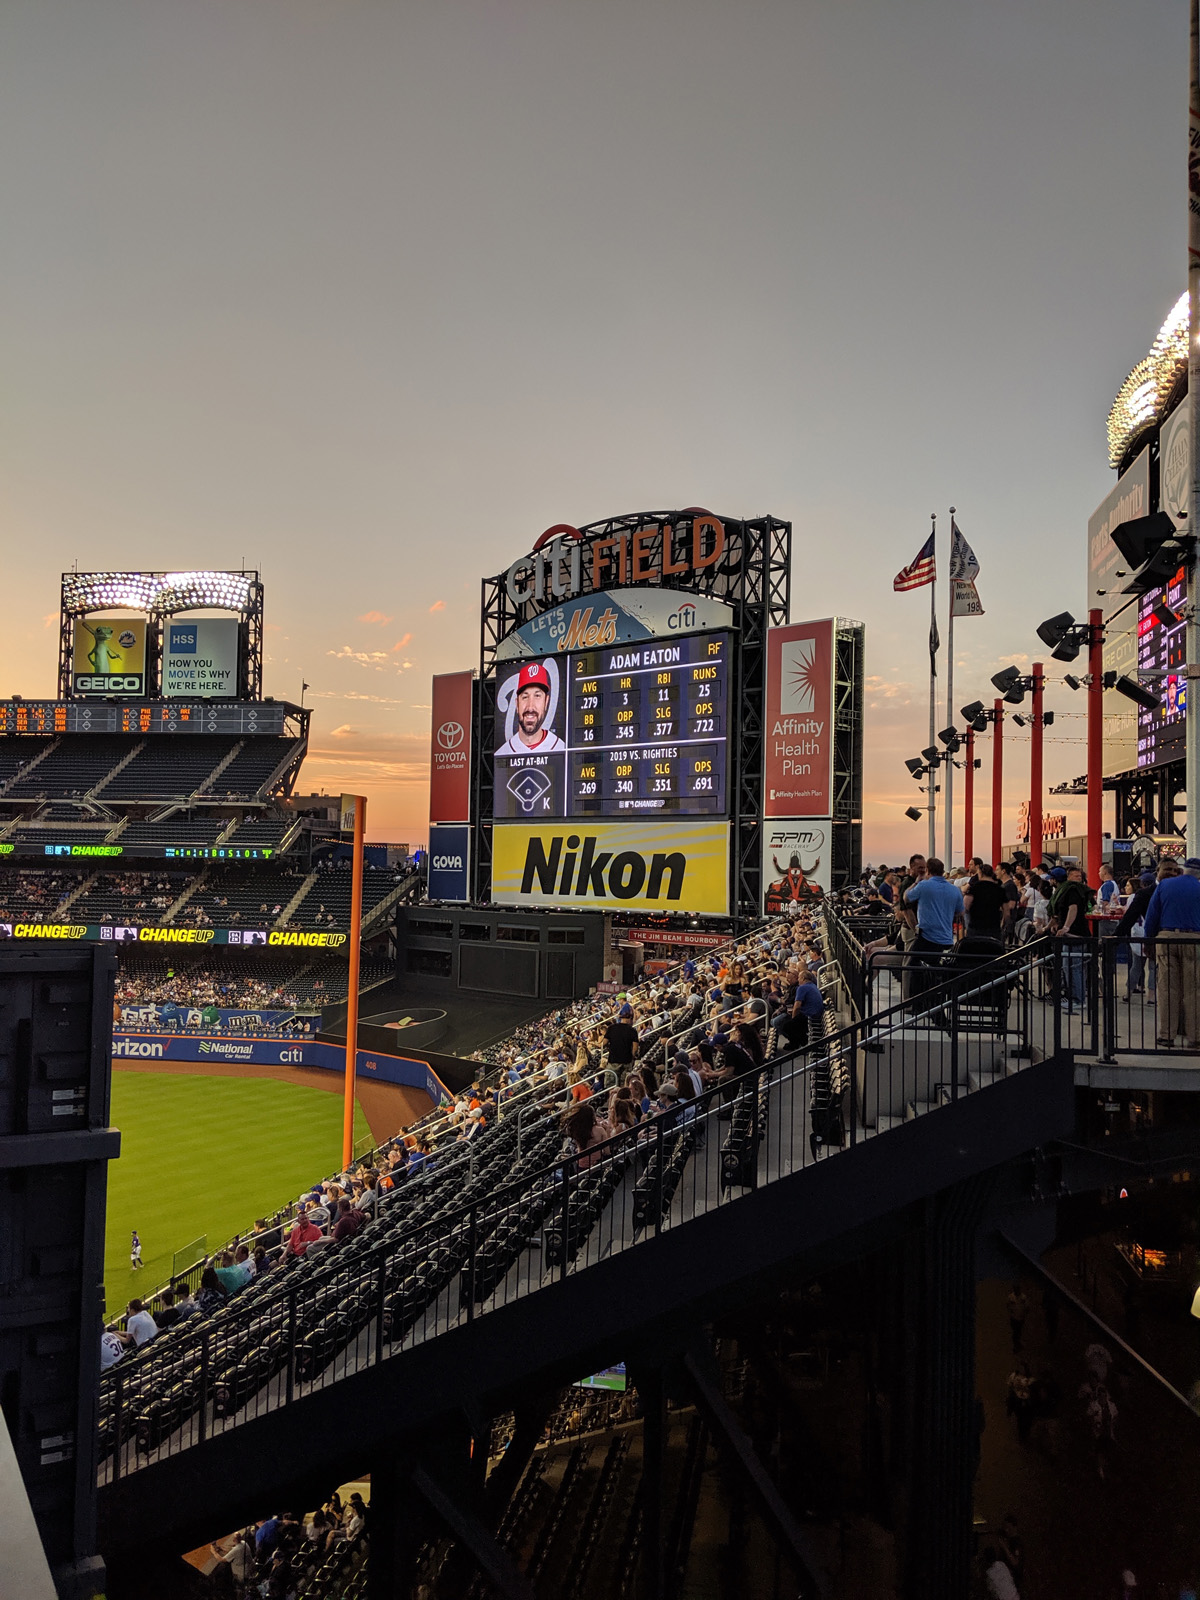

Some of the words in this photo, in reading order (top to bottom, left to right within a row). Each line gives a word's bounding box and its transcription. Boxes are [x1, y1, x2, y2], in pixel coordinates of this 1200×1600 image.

[593, 516, 725, 588] FIELD
[668, 608, 695, 630] citi
[531, 608, 565, 633] LET'S
[549, 621, 565, 639] GO
[557, 607, 617, 651] Mets
[172, 635, 194, 644] HSS
[168, 659, 191, 668] HOW
[193, 659, 213, 668] YOU
[577, 662, 583, 673] 2
[610, 653, 640, 670] ADAM
[643, 647, 680, 666] EATON
[708, 642, 722, 655] RF
[168, 670, 195, 679] MOVE
[197, 670, 207, 679] IS
[208, 670, 231, 679] WHY
[582, 682, 597, 693] AVG
[620, 678, 631, 689] HR
[657, 673, 671, 684] RBI
[693, 667, 717, 680] RUNS
[76, 677, 140, 690] GEICO
[168, 681, 197, 690] WE'RE
[199, 681, 226, 690] HERE.
[580, 697, 598, 709] .279
[623, 694, 628, 705] 3
[658, 690, 669, 701] 11
[699, 685, 710, 697] 25
[584, 715, 594, 725] BB
[617, 711, 633, 722] OBP
[656, 707, 671, 719] SLG
[695, 703, 713, 715] OPS
[583, 730, 594, 741] 16
[615, 726, 634, 738] .345
[653, 723, 673, 735] .377
[693, 719, 714, 732] .722
[772, 719, 824, 737] Affinity
[610, 751, 627, 761] 2019
[629, 750, 641, 760] VS.
[642, 748, 678, 759] RIGHTIES
[775, 739, 819, 757] Health
[434, 752, 467, 763] TOYOTA
[510, 757, 525, 767] LAST
[526, 756, 548, 766] AT-BAT
[580, 767, 596, 778] AVG
[616, 765, 632, 776] OBP
[655, 763, 670, 775] SLG
[695, 761, 712, 773] OPS
[783, 760, 811, 776] Plan
[579, 783, 597, 794] .269
[615, 781, 633, 793] .340
[653, 779, 672, 791] .351
[692, 778, 713, 791] .691
[776, 791, 794, 799] Affinity
[811, 789, 822, 797] Plan
[543, 797, 550, 810] K
[770, 832, 813, 843] RPM
[71, 846, 123, 856] CHANGEUP
[433, 855, 462, 869] GOYA
[520, 834, 686, 900] Nikon
[14, 924, 87, 939] CHANGEUP
[139, 927, 215, 943] CHANGEUP
[268, 931, 346, 947] CHANGEUP
[663, 934, 682, 942] BEAM
[685, 936, 718, 944] BOURBON
[111, 1038, 163, 1057] erizon
[210, 1042, 253, 1054] National
[279, 1048, 303, 1062] citi
[365, 1061, 377, 1071] 408
